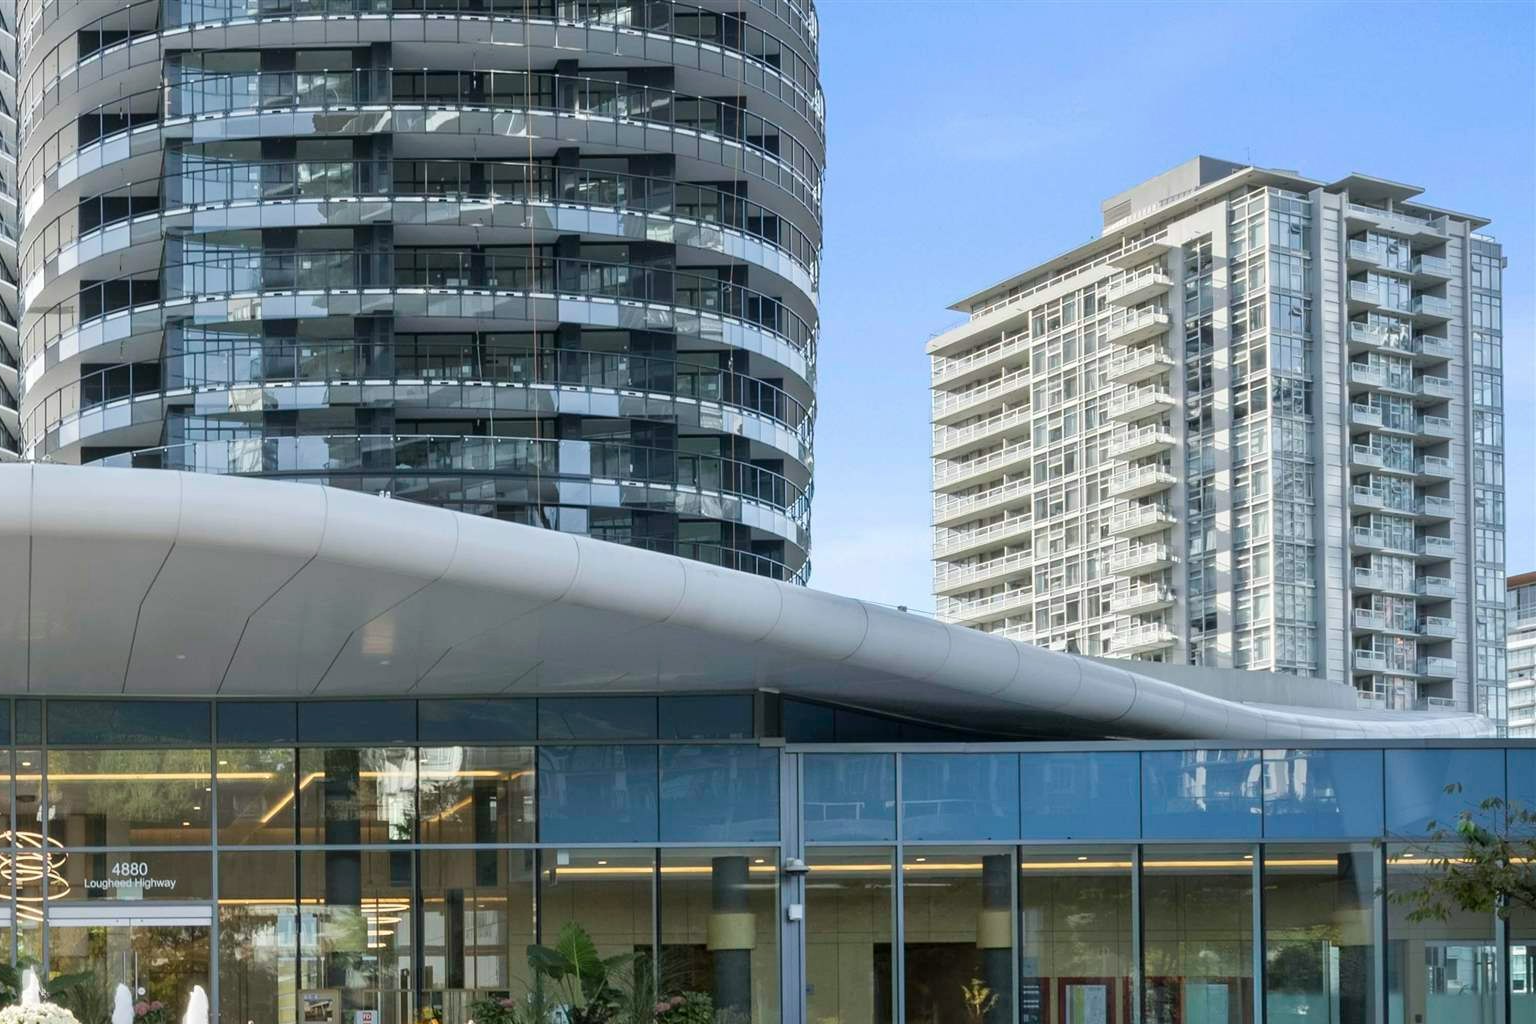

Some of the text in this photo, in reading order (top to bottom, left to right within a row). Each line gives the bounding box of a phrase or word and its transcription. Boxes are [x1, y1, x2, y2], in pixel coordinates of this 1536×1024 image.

[111, 862, 148, 876] 4880
[84, 878, 177, 890] Lougheed Highway
